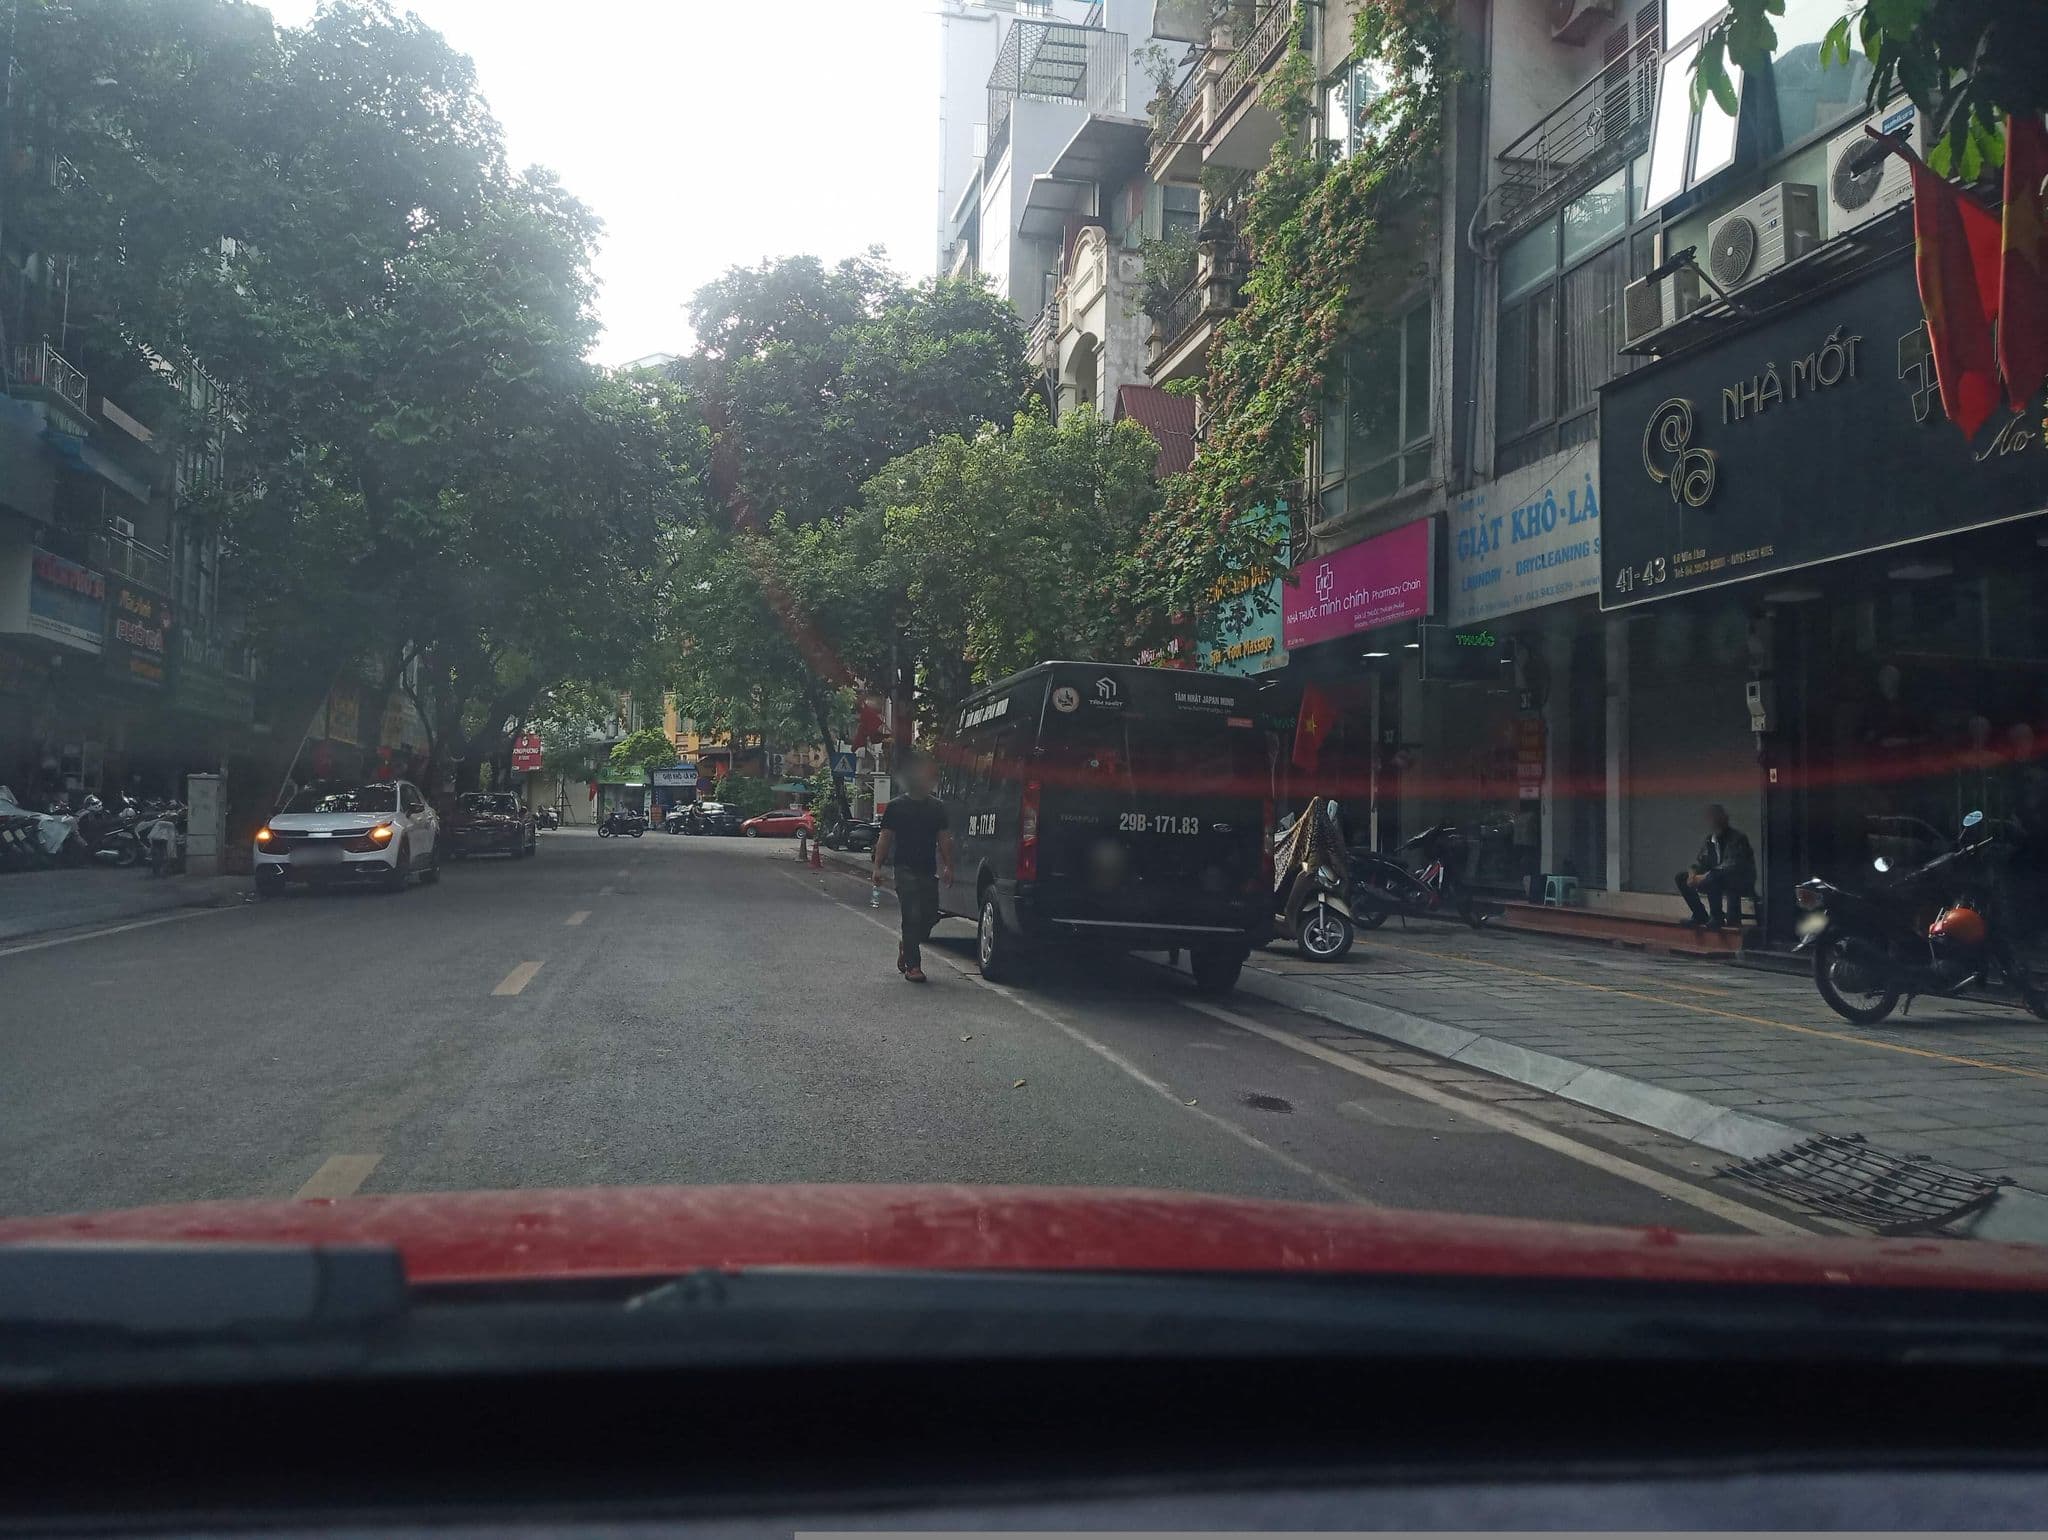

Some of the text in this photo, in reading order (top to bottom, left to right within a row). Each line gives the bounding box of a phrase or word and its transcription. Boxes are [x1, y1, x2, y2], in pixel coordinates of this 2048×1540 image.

[1722, 361, 1783, 425] NHÀ
[1791, 324, 1863, 399] MỐT
[1457, 512, 1503, 562] GIẶT
[1511, 488, 1557, 545] KHÔ
[1461, 567, 1502, 593] LAUNDRY
[1515, 542, 1590, 577] DRYCLEANING
[1615, 557, 1666, 593] 41-43
[1287, 578, 1421, 625] NHÀ THUỐC minh chính Pharmacy Chain
[1243, 636, 1273, 658] Massage
[1119, 812, 1199, 835] 29B-171.83
